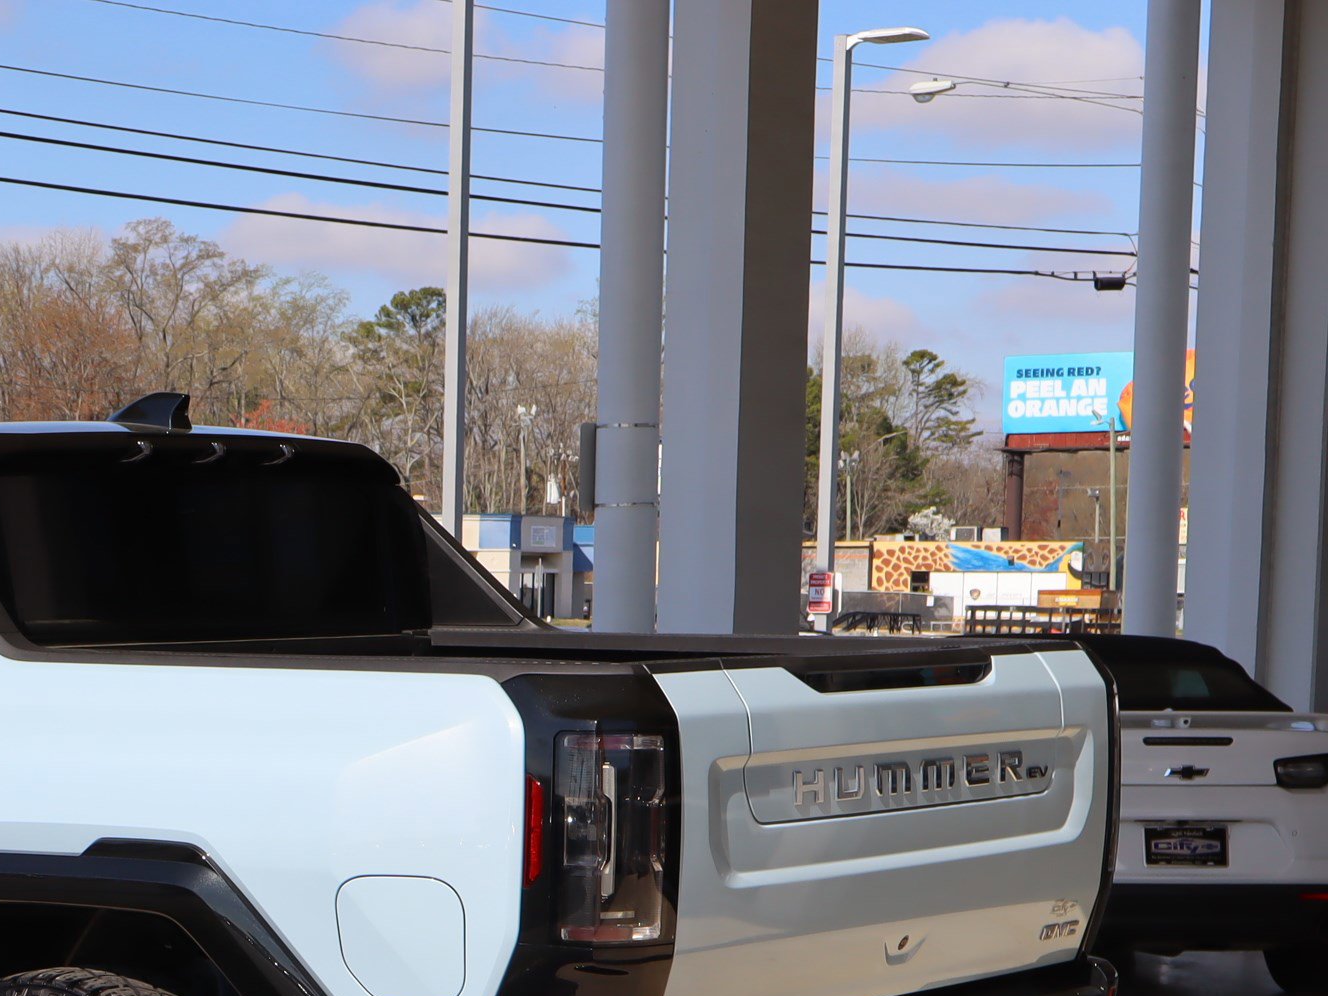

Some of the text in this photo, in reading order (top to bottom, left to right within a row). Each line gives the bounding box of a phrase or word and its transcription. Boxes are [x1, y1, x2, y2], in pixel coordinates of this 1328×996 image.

[1016, 366, 1102, 378] SEEING RED?
[1010, 378, 1107, 399] PEEL AN
[1007, 398, 1108, 418] ORANGE
[814, 588, 825, 596] NO
[794, 751, 1049, 806] HUMMER EV
[1039, 920, 1080, 941] GMC
